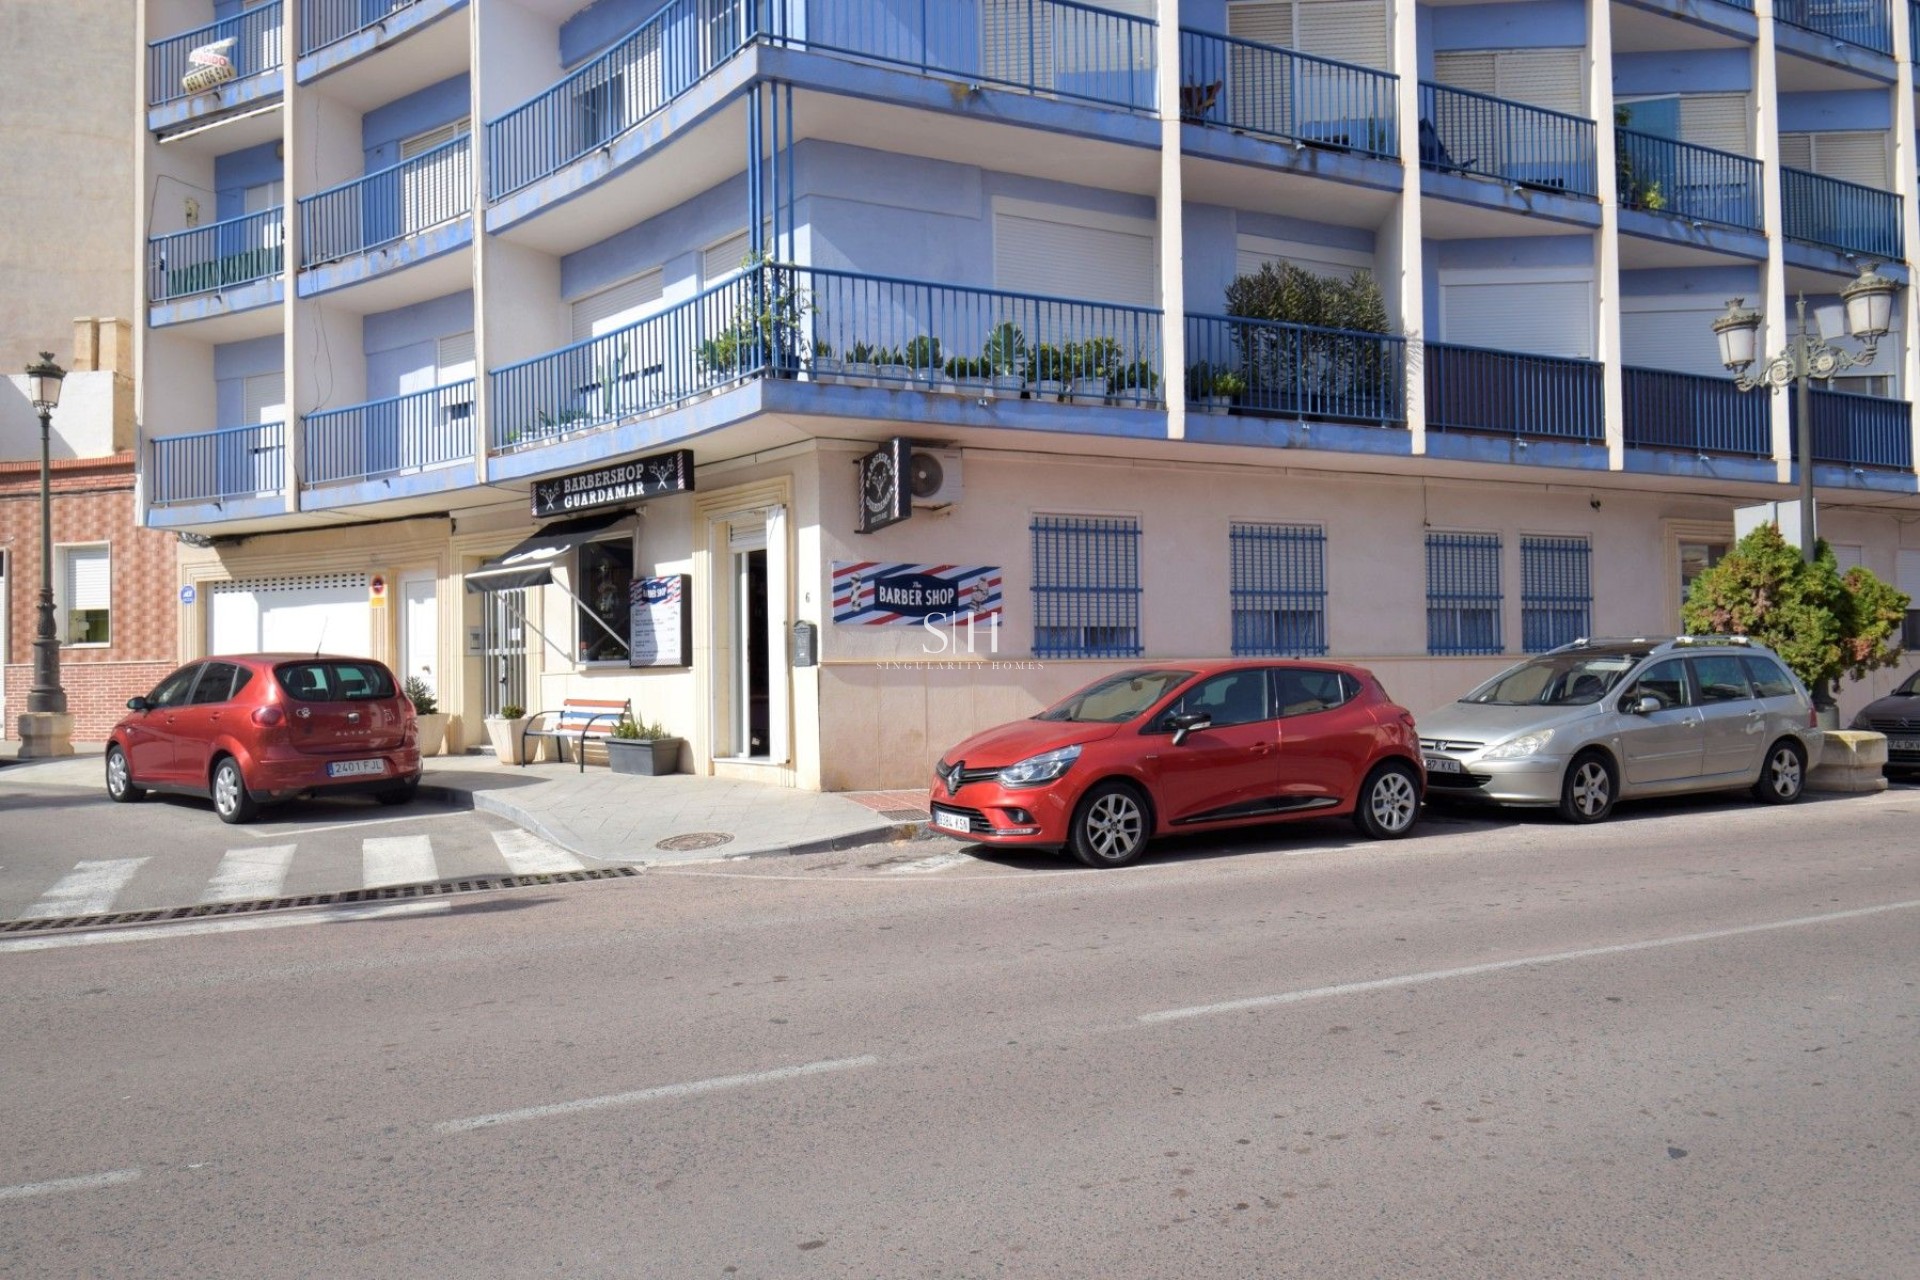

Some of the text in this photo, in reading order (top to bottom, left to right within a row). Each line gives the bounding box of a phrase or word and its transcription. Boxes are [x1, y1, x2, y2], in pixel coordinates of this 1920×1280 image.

[564, 463, 645, 493] BARBERSHOP
[564, 481, 645, 508] GUARDAMAR
[879, 585, 955, 606] BARBER SHOP
[335, 760, 382, 773] 2401 FJL
